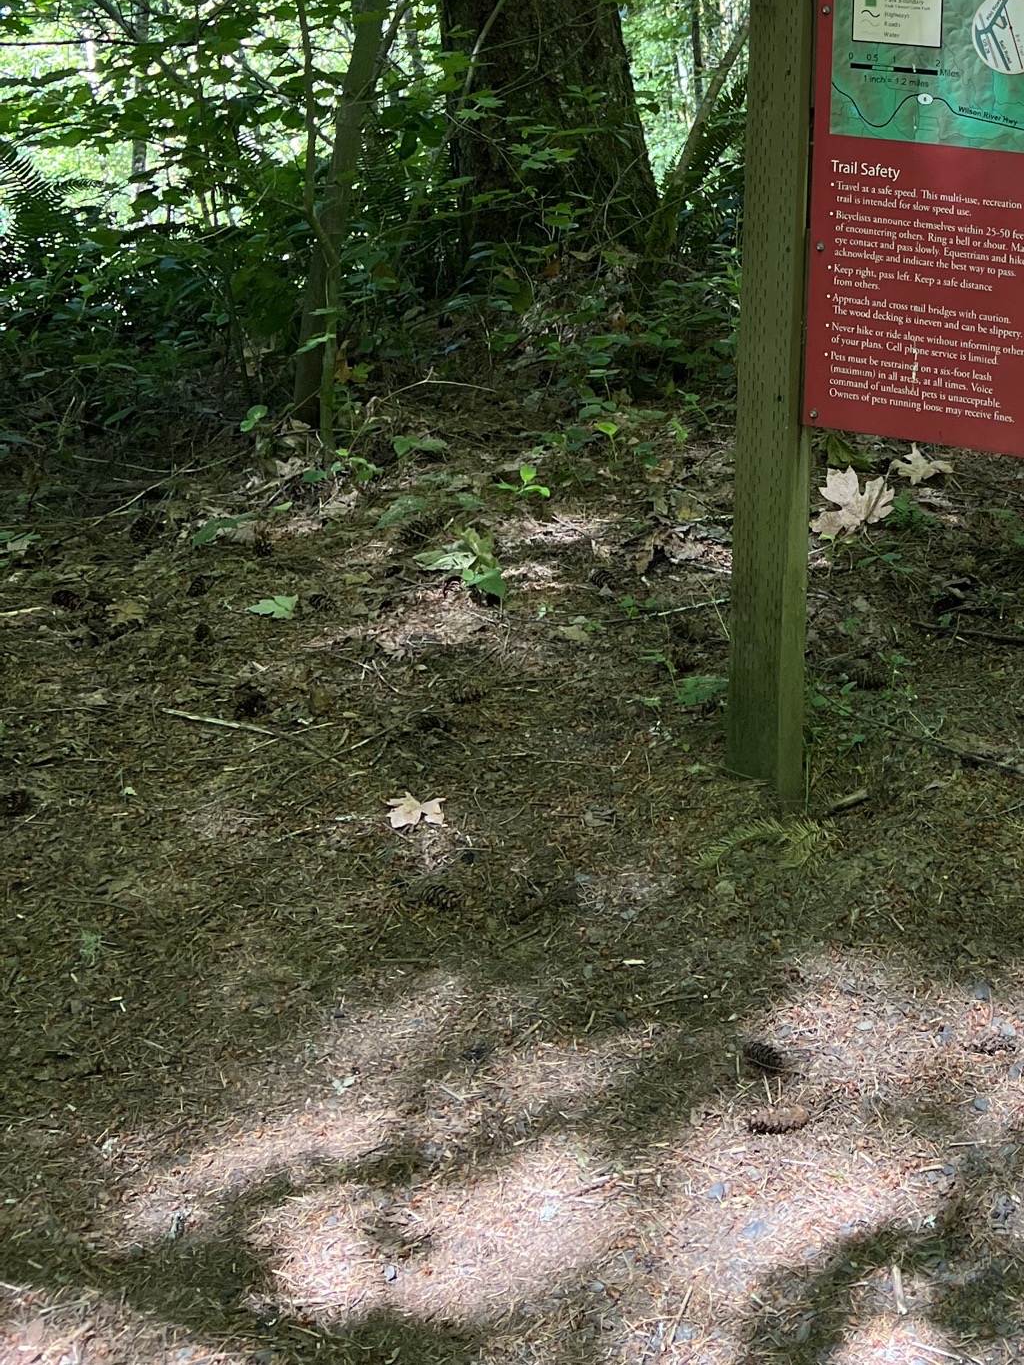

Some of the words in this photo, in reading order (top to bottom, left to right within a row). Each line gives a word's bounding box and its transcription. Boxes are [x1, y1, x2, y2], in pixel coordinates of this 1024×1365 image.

[884, 11, 910, 19] Highways
[939, 68, 960, 78] Miles
[869, 75, 886, 83] inch
[896, 77, 907, 86] 1.2
[908, 78, 930, 89] miles
[958, 106, 982, 117] Wilson
[982, 111, 1001, 121] River
[1001, 115, 1018, 127] Hwy
[831, 159, 858, 175] Trail
[860, 162, 900, 182] Safety
[836, 180, 860, 192] Travel
[877, 185, 893, 195] safe
[894, 188, 918, 199] speed.
[920, 189, 938, 200] This
[940, 192, 980, 206] multi-use,
[982, 199, 1022, 210] recreation
